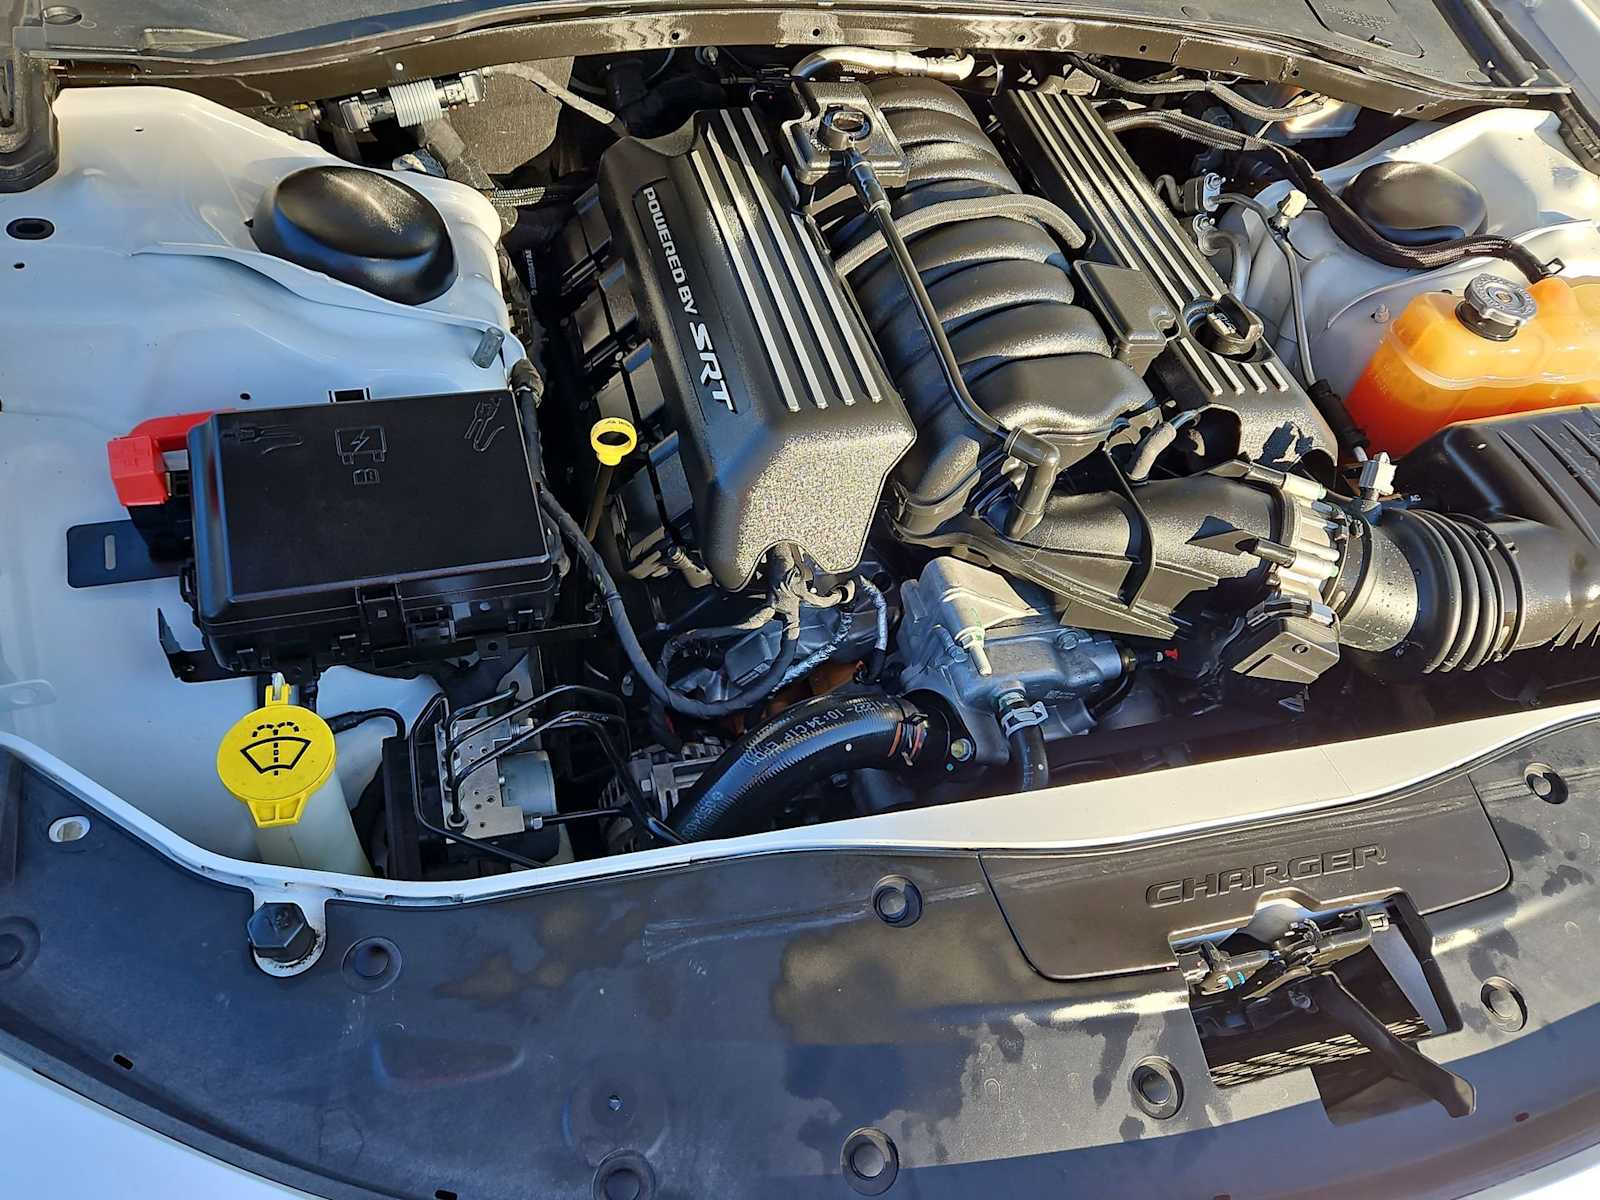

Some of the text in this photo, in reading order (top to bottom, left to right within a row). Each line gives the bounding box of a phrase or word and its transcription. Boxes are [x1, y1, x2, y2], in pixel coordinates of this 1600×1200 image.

[643, 186, 736, 412] POWERED BY SRT
[1146, 843, 1387, 908] CHARGER
